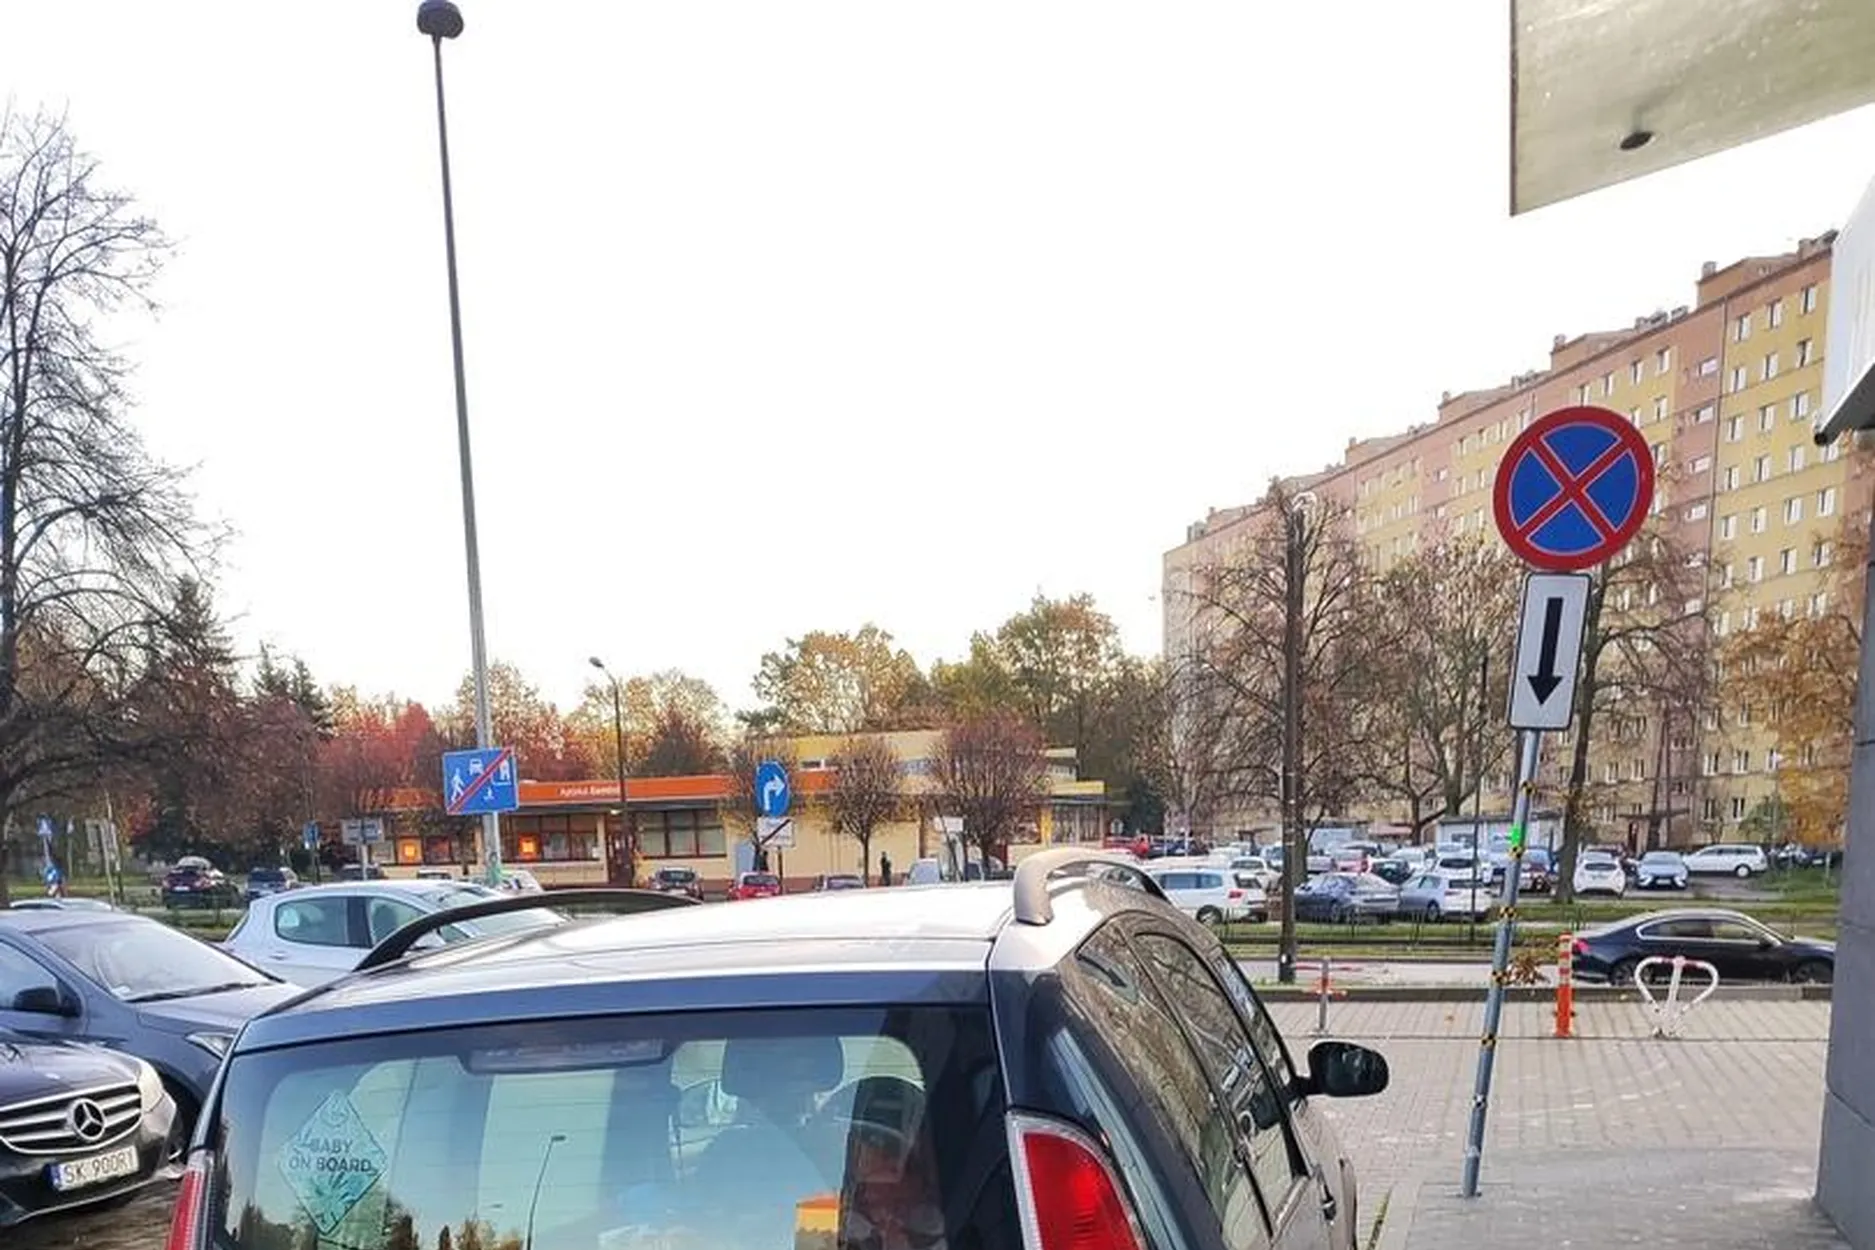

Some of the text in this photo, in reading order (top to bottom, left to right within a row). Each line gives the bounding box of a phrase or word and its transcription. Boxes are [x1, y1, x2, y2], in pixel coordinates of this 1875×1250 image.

[311, 1138, 353, 1153] BABY
[64, 1163, 87, 1183] SK
[289, 1157, 372, 1173] ON BOARD
